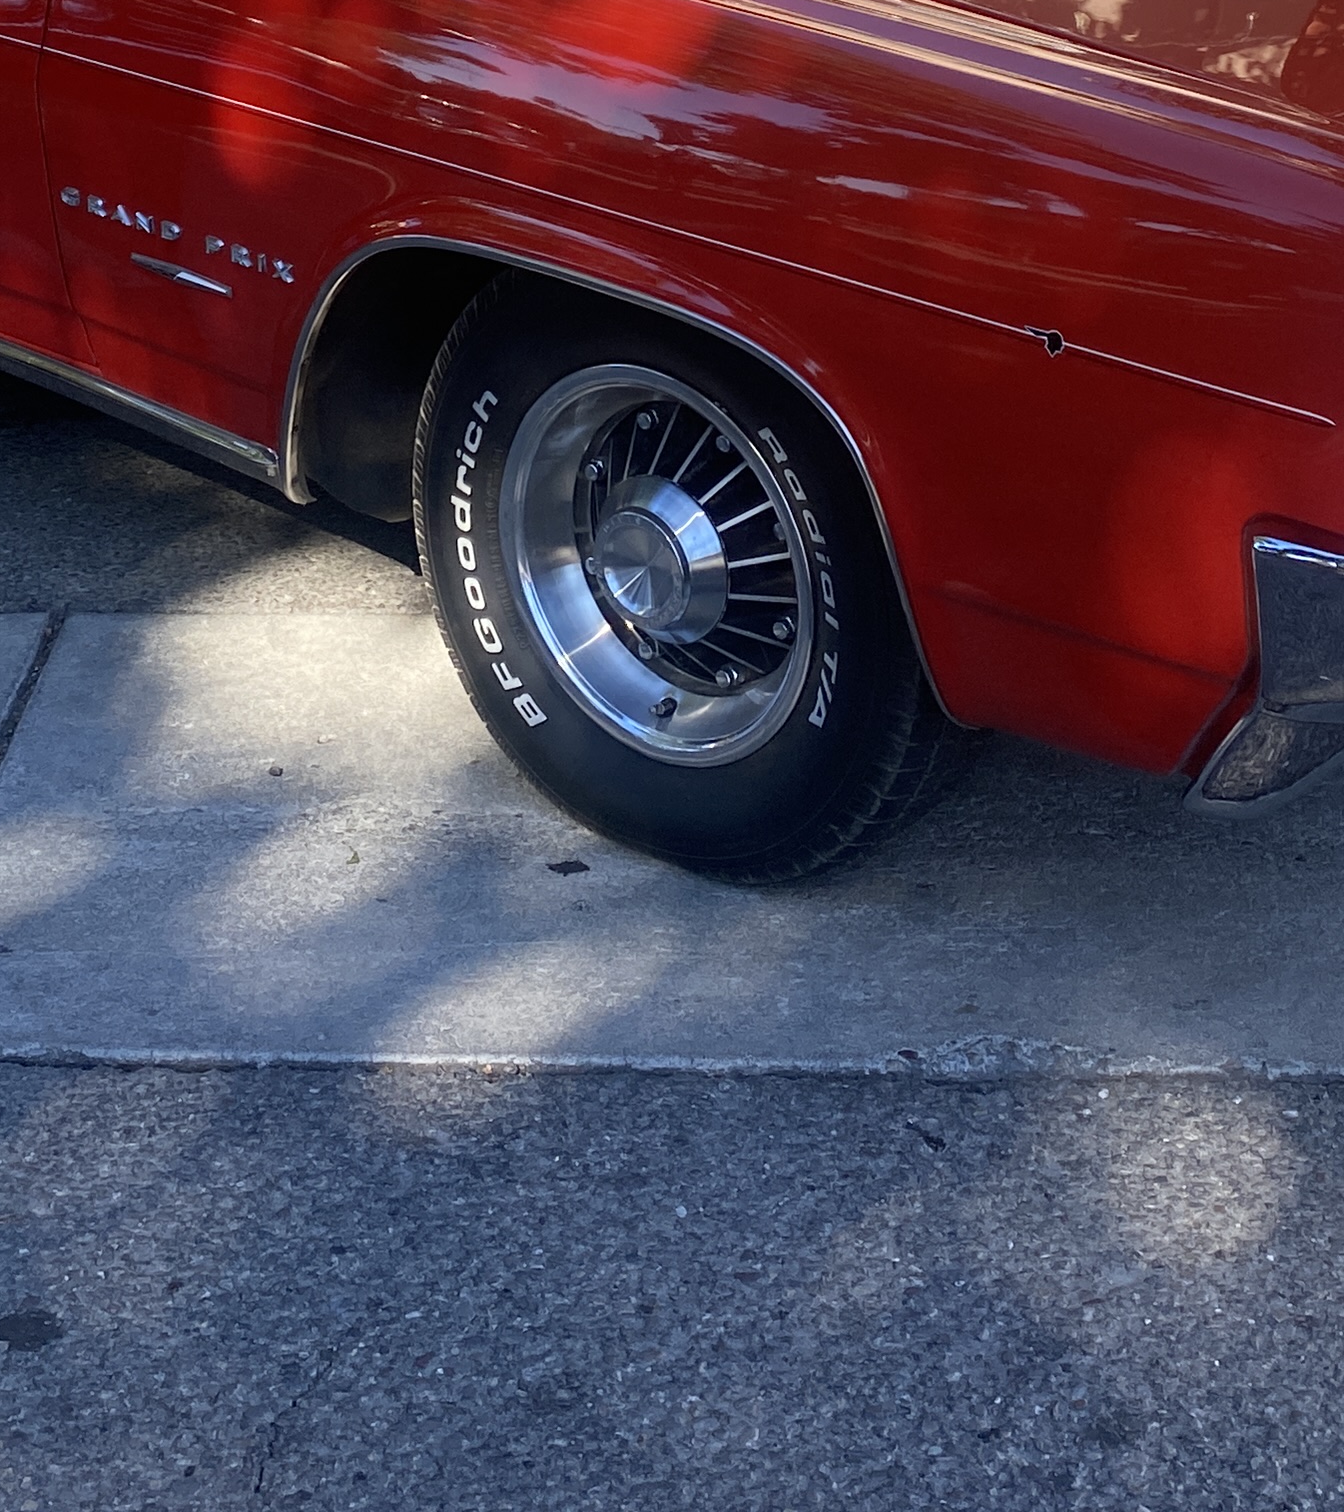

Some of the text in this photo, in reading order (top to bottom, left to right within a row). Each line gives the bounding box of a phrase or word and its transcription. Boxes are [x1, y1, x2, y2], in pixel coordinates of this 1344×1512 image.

[60, 186, 295, 284] GRAND PRIX
[450, 390, 548, 728] BFGoodrich
[757, 426, 840, 729] Radial T/A
